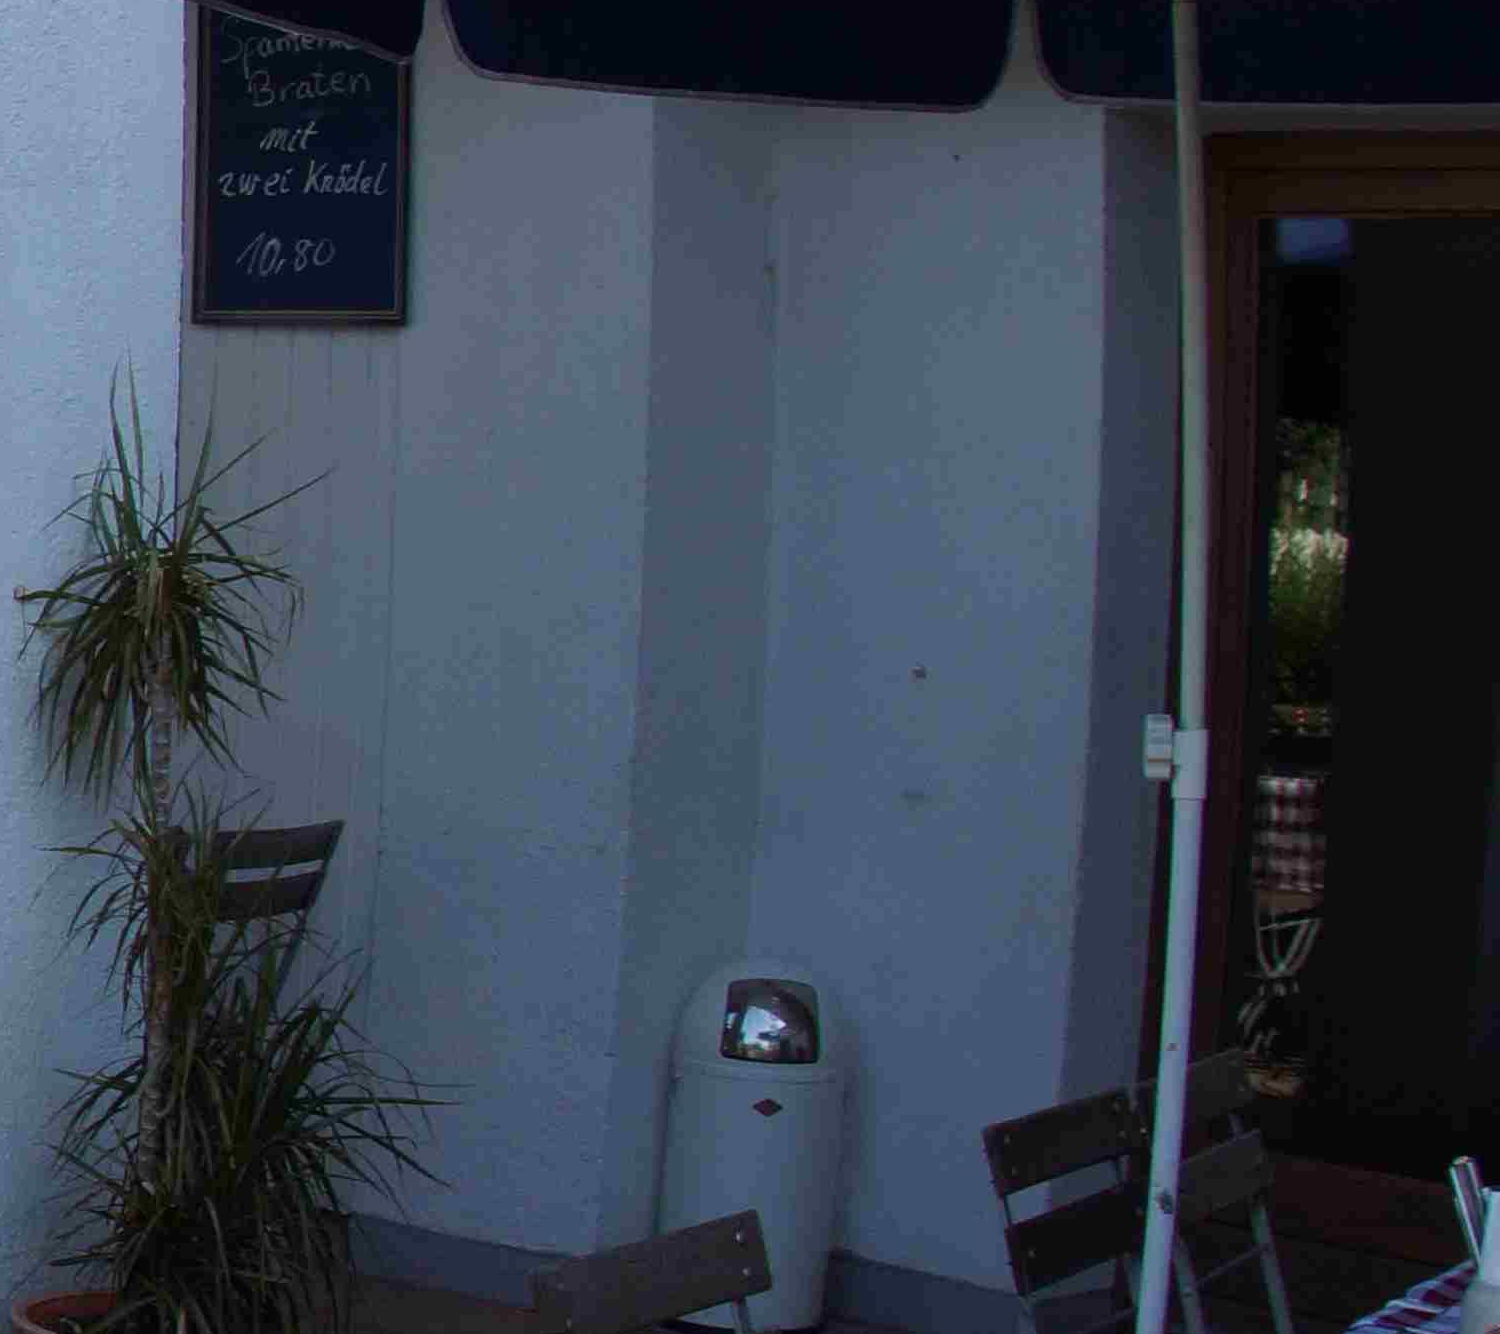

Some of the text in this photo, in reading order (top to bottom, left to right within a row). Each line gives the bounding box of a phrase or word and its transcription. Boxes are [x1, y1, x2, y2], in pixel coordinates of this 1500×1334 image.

[248, 65, 371, 107] Braten
[260, 121, 319, 152] mit
[219, 160, 389, 197] zwei Knödel
[236, 232, 337, 276] 10,80
